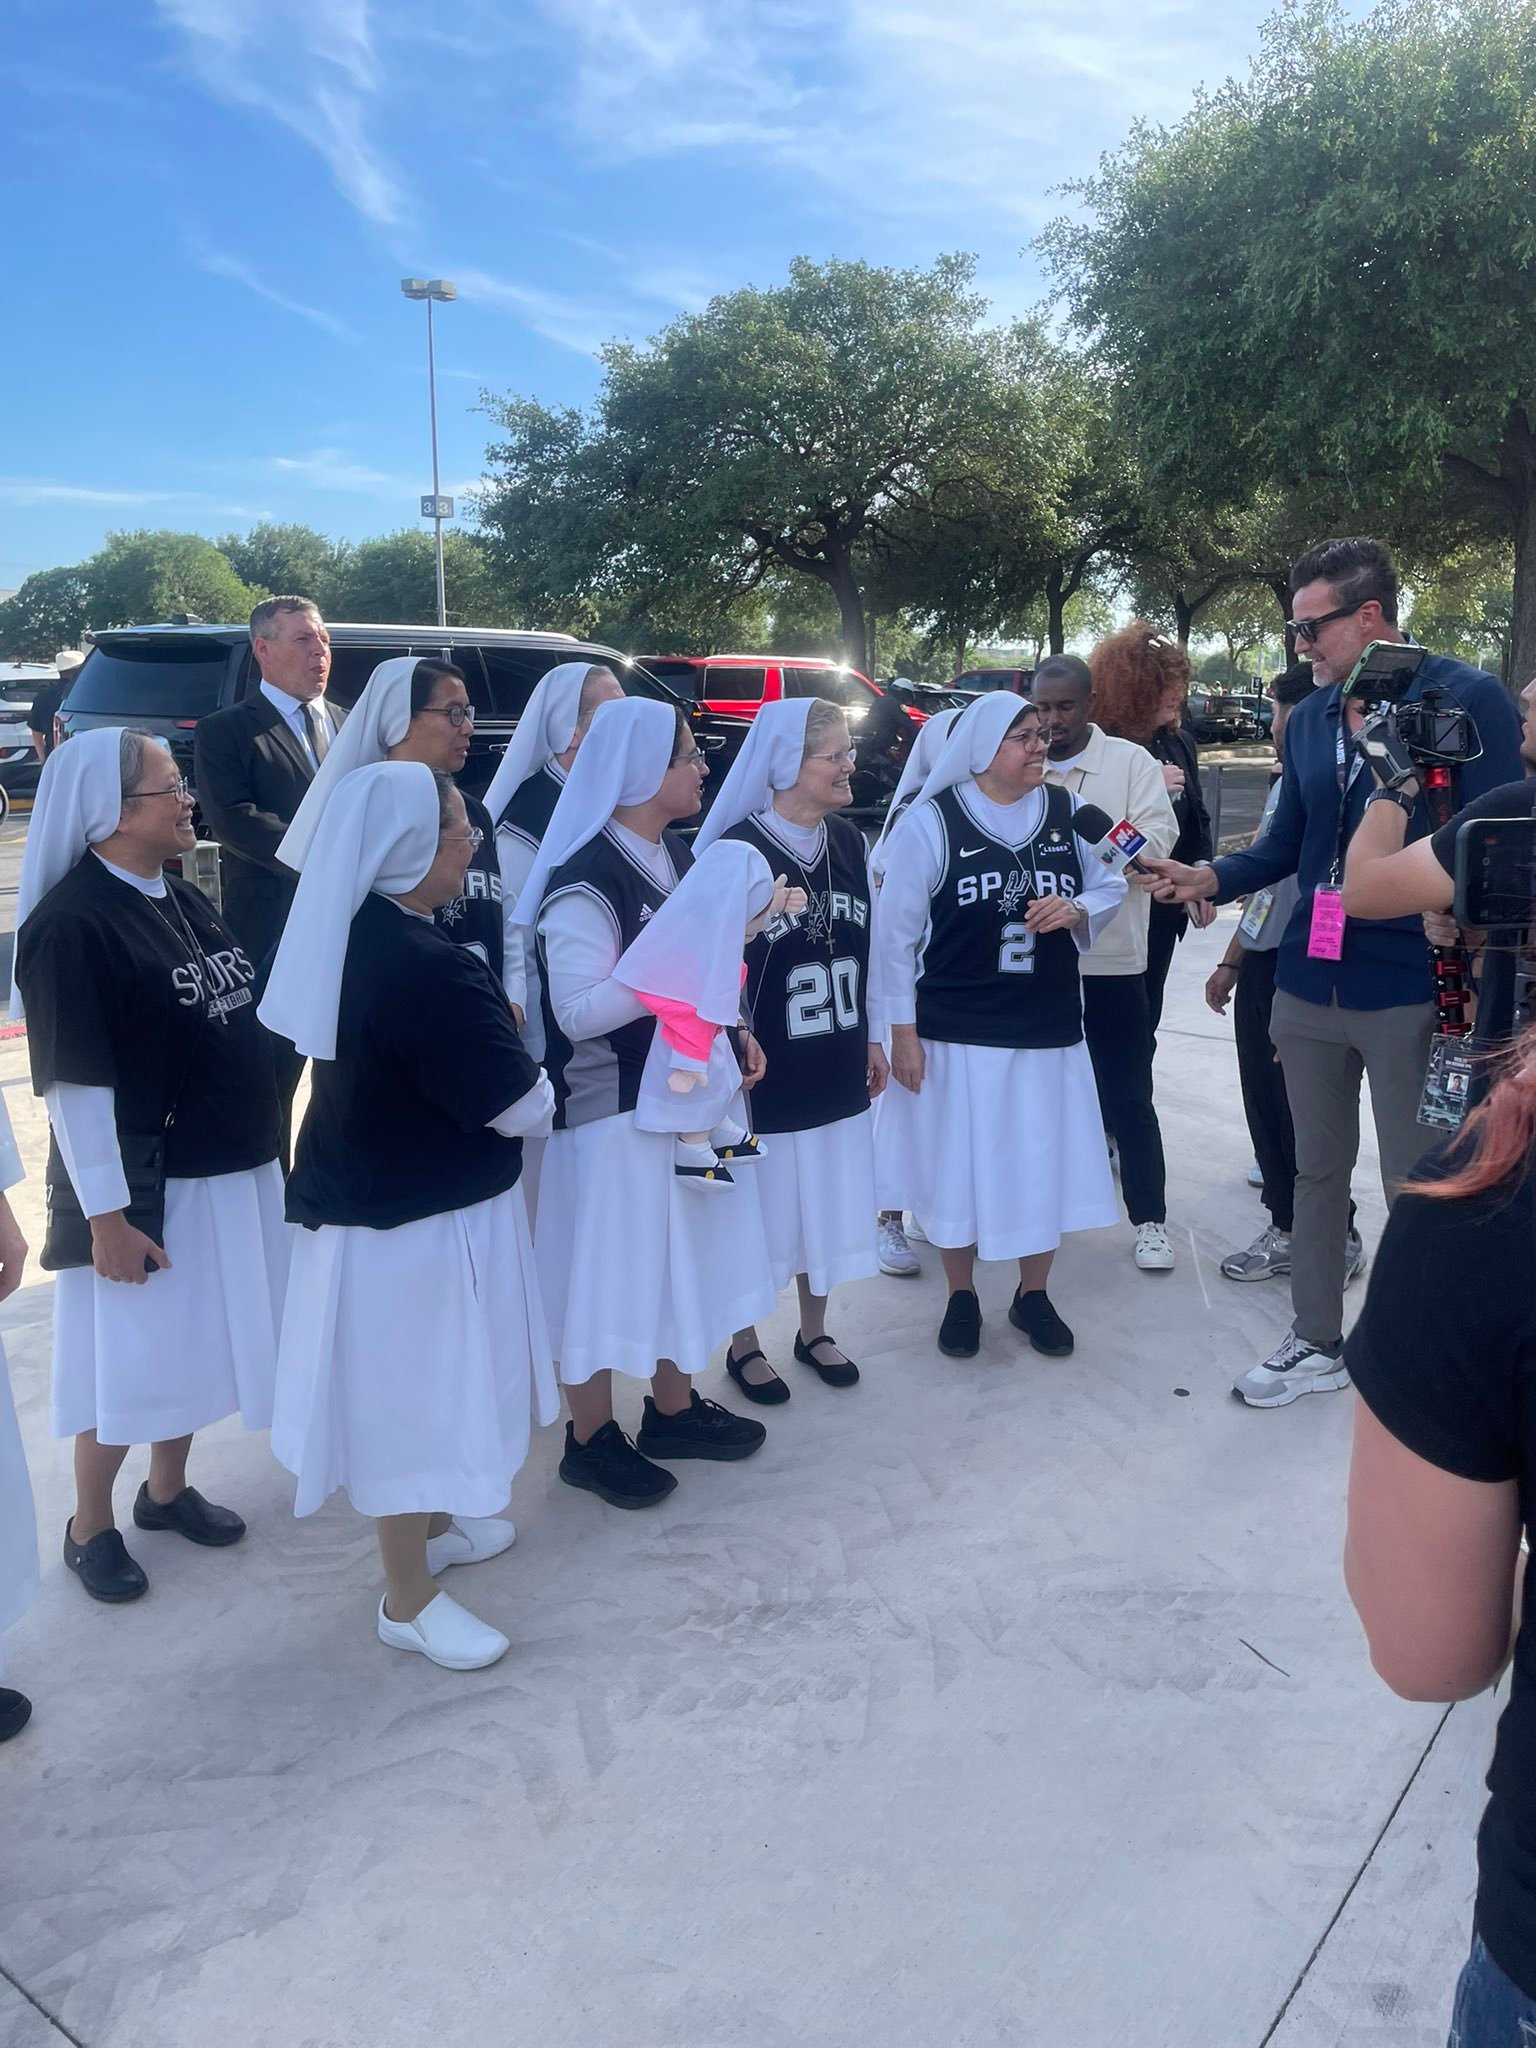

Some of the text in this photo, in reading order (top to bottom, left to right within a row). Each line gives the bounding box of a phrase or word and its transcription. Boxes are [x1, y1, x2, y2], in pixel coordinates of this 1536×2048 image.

[957, 870, 1076, 908] SPURS
[998, 921, 1038, 974] 2
[171, 946, 255, 1007] SPURS
[786, 957, 860, 1040] 20
